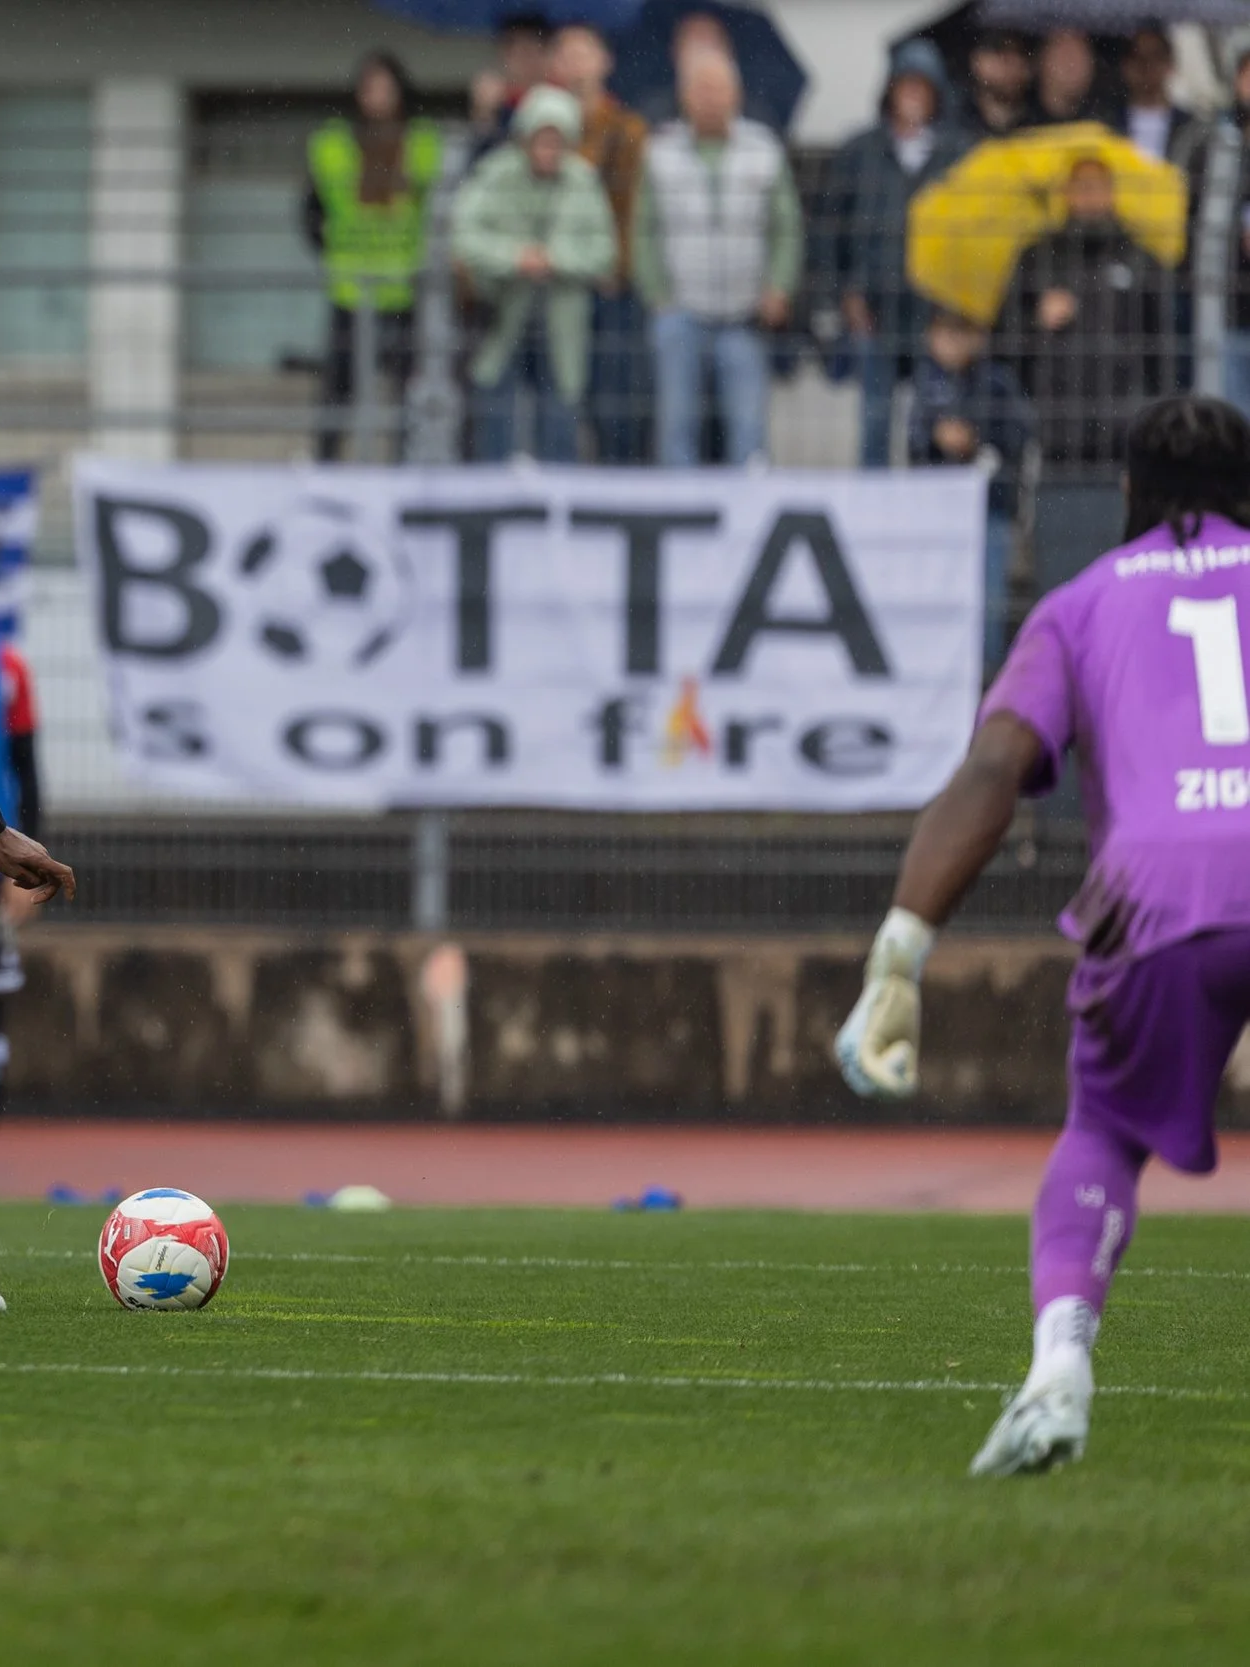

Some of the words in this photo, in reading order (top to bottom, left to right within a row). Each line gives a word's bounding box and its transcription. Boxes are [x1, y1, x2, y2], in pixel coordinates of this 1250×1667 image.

[1167, 595, 1249, 746] 1
[281, 704, 512, 773] on
[1174, 767, 1250, 813] ZIG
